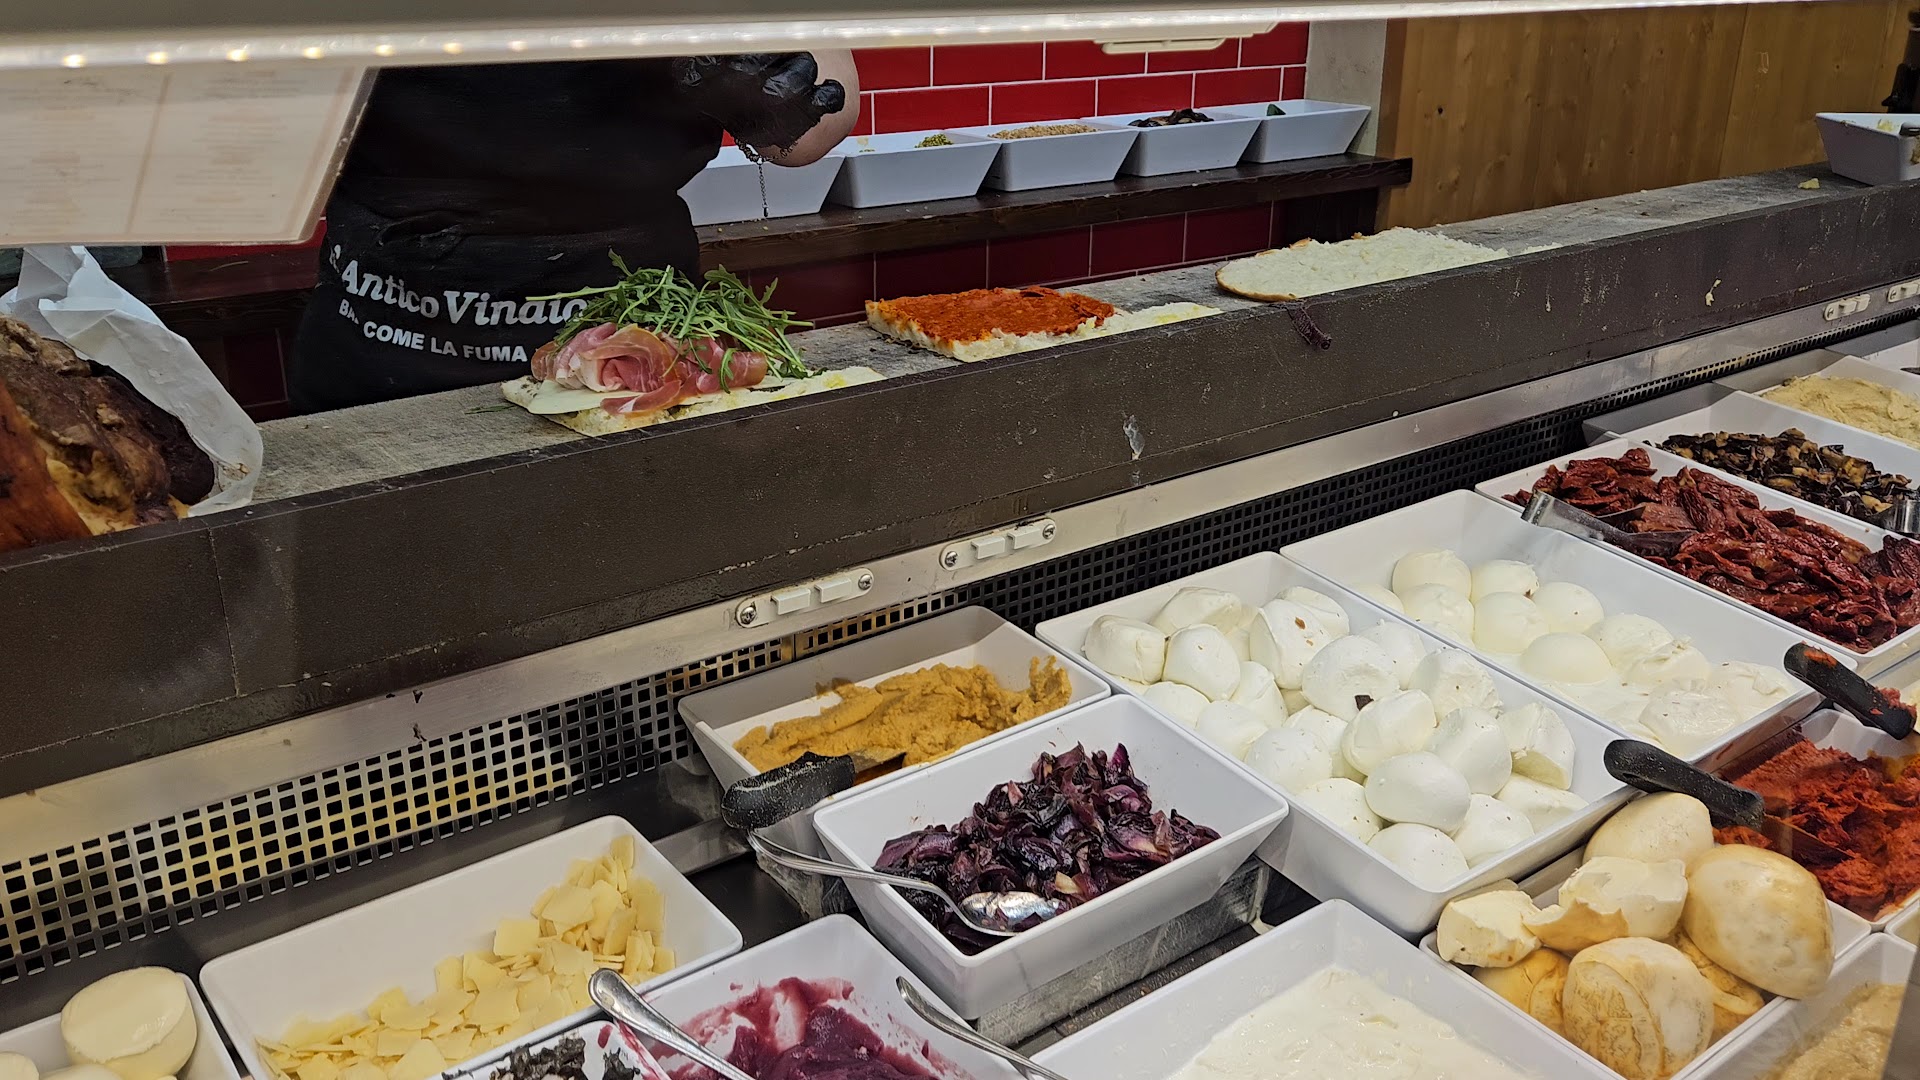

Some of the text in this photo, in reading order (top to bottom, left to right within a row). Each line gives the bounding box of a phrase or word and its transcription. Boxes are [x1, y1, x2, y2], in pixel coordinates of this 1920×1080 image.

[363, 321, 425, 351] COME
[430, 337, 458, 357] LA
[463, 345, 528, 363] FUMA
